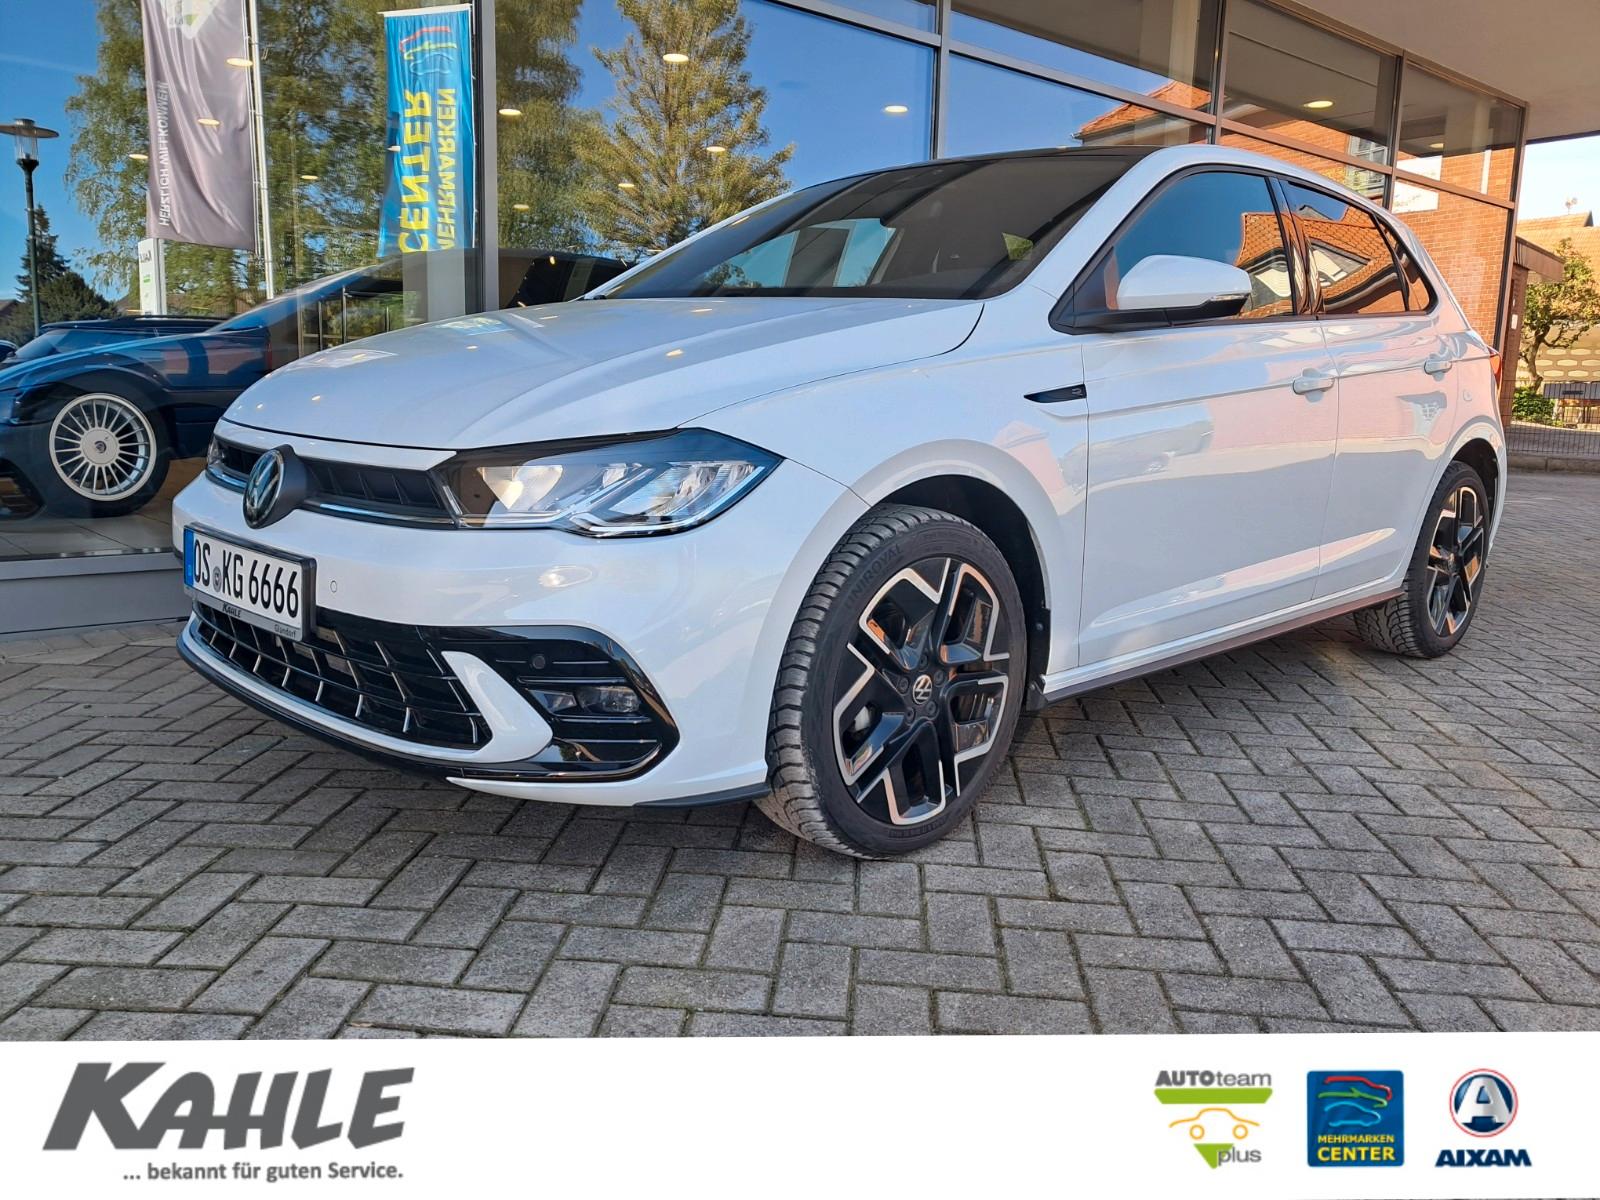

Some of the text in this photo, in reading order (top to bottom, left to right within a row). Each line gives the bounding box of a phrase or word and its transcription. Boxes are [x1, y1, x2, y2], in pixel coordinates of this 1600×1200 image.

[193, 538, 299, 619] OS KG 6666
